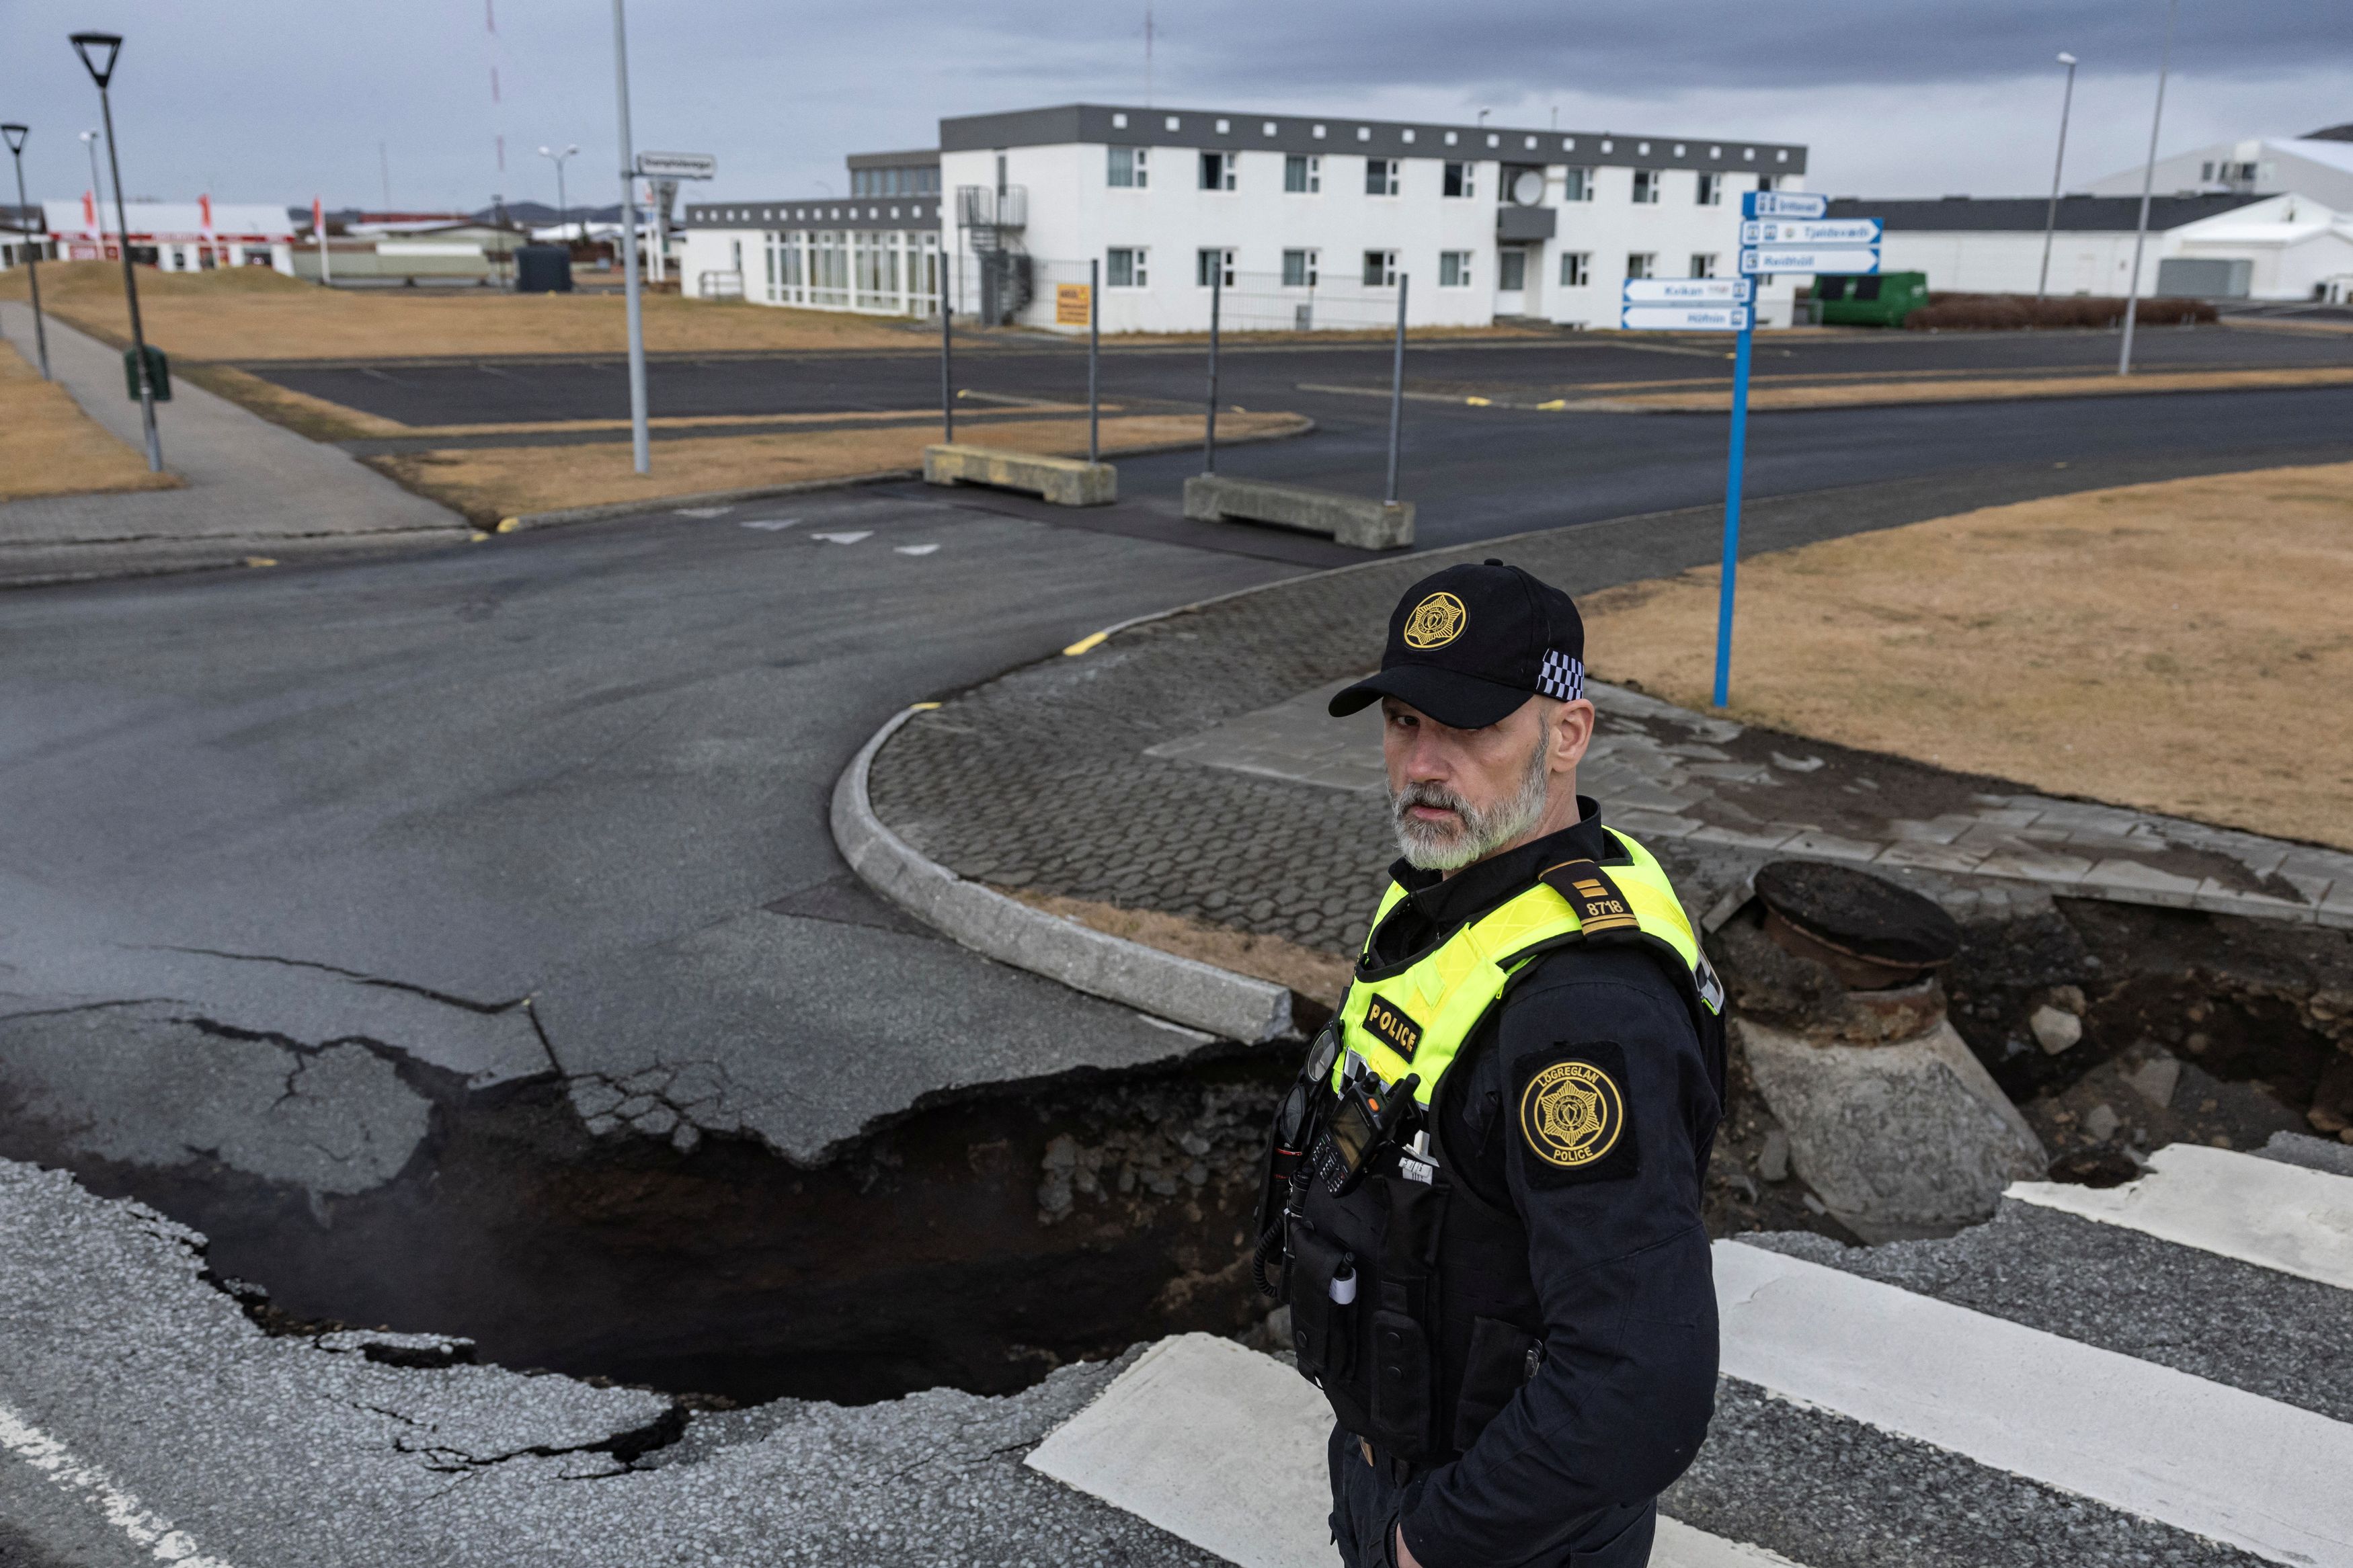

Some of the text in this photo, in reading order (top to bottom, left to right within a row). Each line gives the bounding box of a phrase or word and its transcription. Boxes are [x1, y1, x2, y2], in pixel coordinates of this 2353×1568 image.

[1586, 900, 1624, 916] 8718
[1369, 1003, 1417, 1053] POLICE
[1538, 1066, 1600, 1087] LÖGREGLAN
[1553, 1146, 1594, 1161] POLICE
